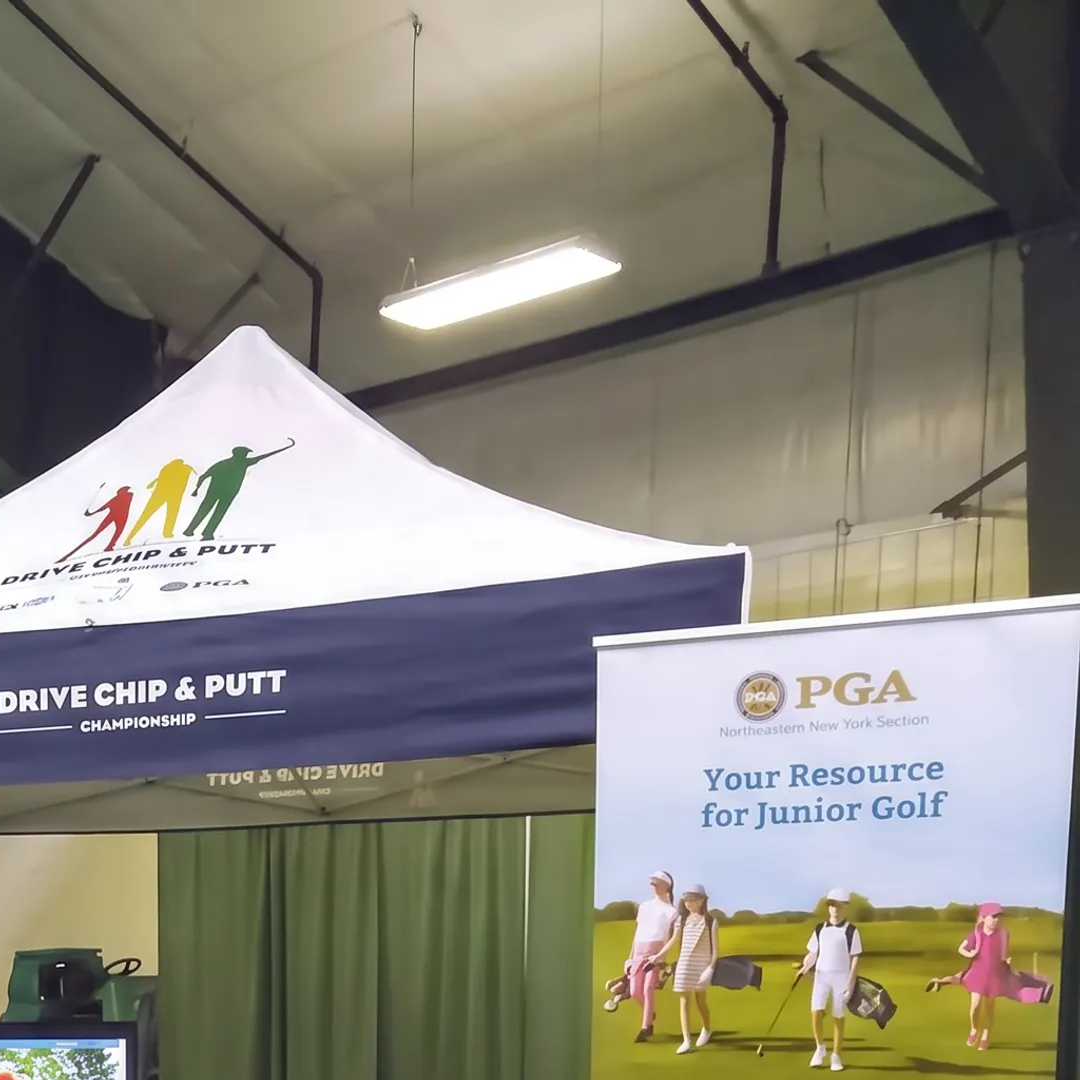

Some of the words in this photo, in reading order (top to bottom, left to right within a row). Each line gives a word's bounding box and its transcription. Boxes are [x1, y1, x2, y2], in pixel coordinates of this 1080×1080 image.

[1, 562, 84, 586] DRIVE
[93, 549, 161, 568] CHIP
[169, 546, 188, 558] &
[197, 544, 276, 556] PUTT
[192, 579, 250, 589] PGA
[94, 678, 167, 706] CHIP
[174, 675, 197, 700] &
[204, 669, 286, 698] PUTT
[795, 669, 917, 709] PGA
[80, 712, 196, 733] CHAMPIONSHIP
[720, 724, 805, 738] Northeastern
[810, 720, 839, 732] New
[843, 717, 873, 730] York
[876, 714, 930, 728] Section
[703, 768, 780, 792] Your
[788, 760, 945, 788] Resource
[701, 802, 749, 828] for
[754, 797, 862, 830] Junior
[871, 791, 948, 820] Golf
